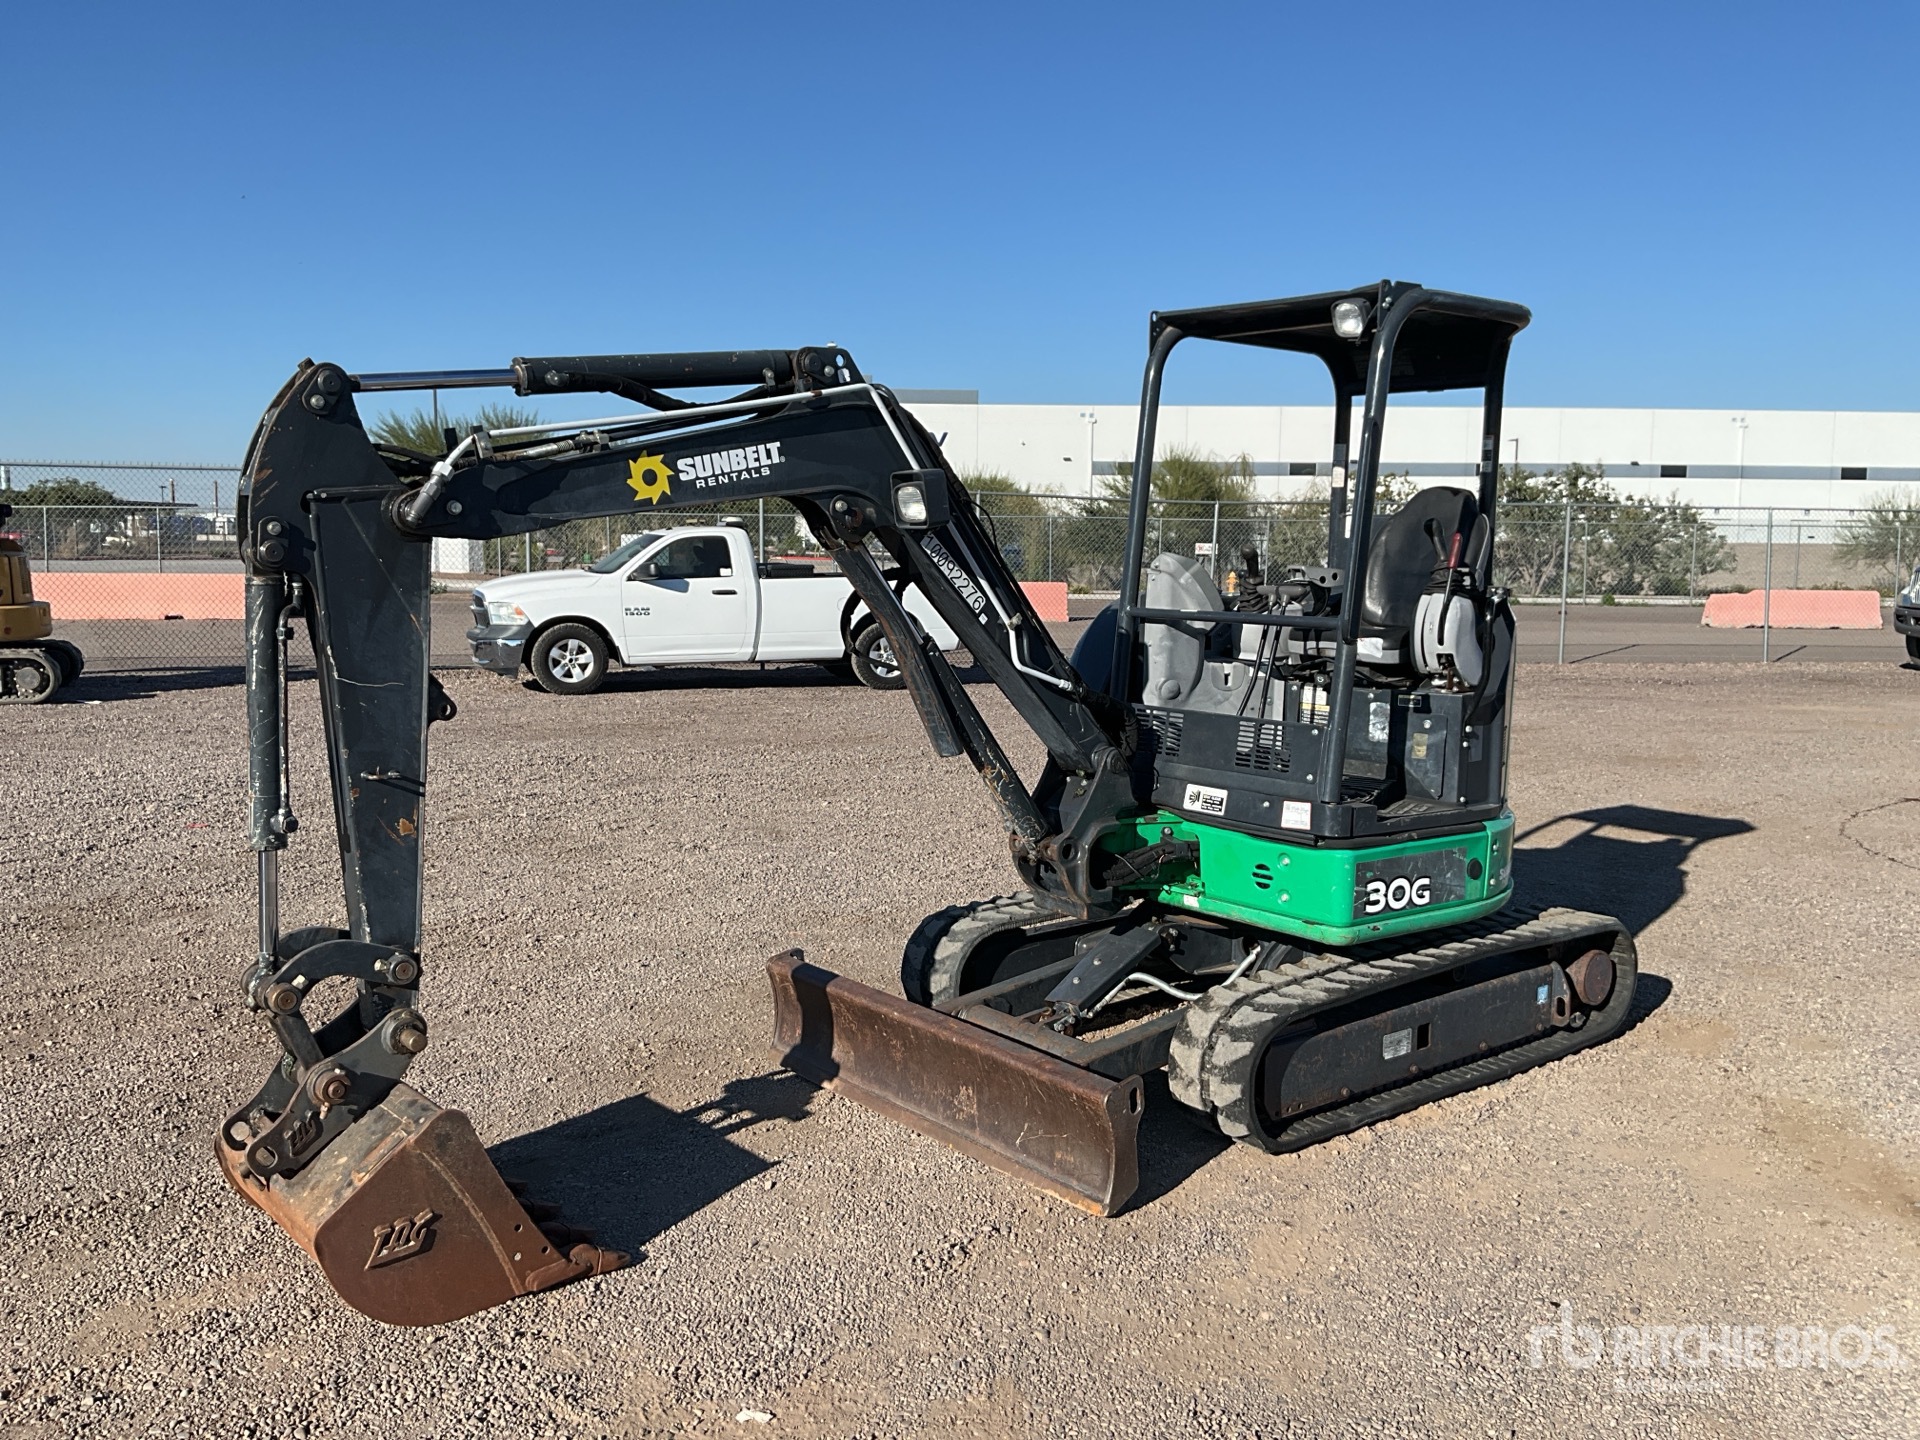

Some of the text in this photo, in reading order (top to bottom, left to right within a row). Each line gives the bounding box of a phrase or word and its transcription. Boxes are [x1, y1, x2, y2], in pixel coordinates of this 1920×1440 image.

[676, 441, 781, 481] SUNBELT
[695, 466, 771, 489] RENTALS
[924, 533, 985, 611] 10092276
[1364, 876, 1431, 914] 30G
